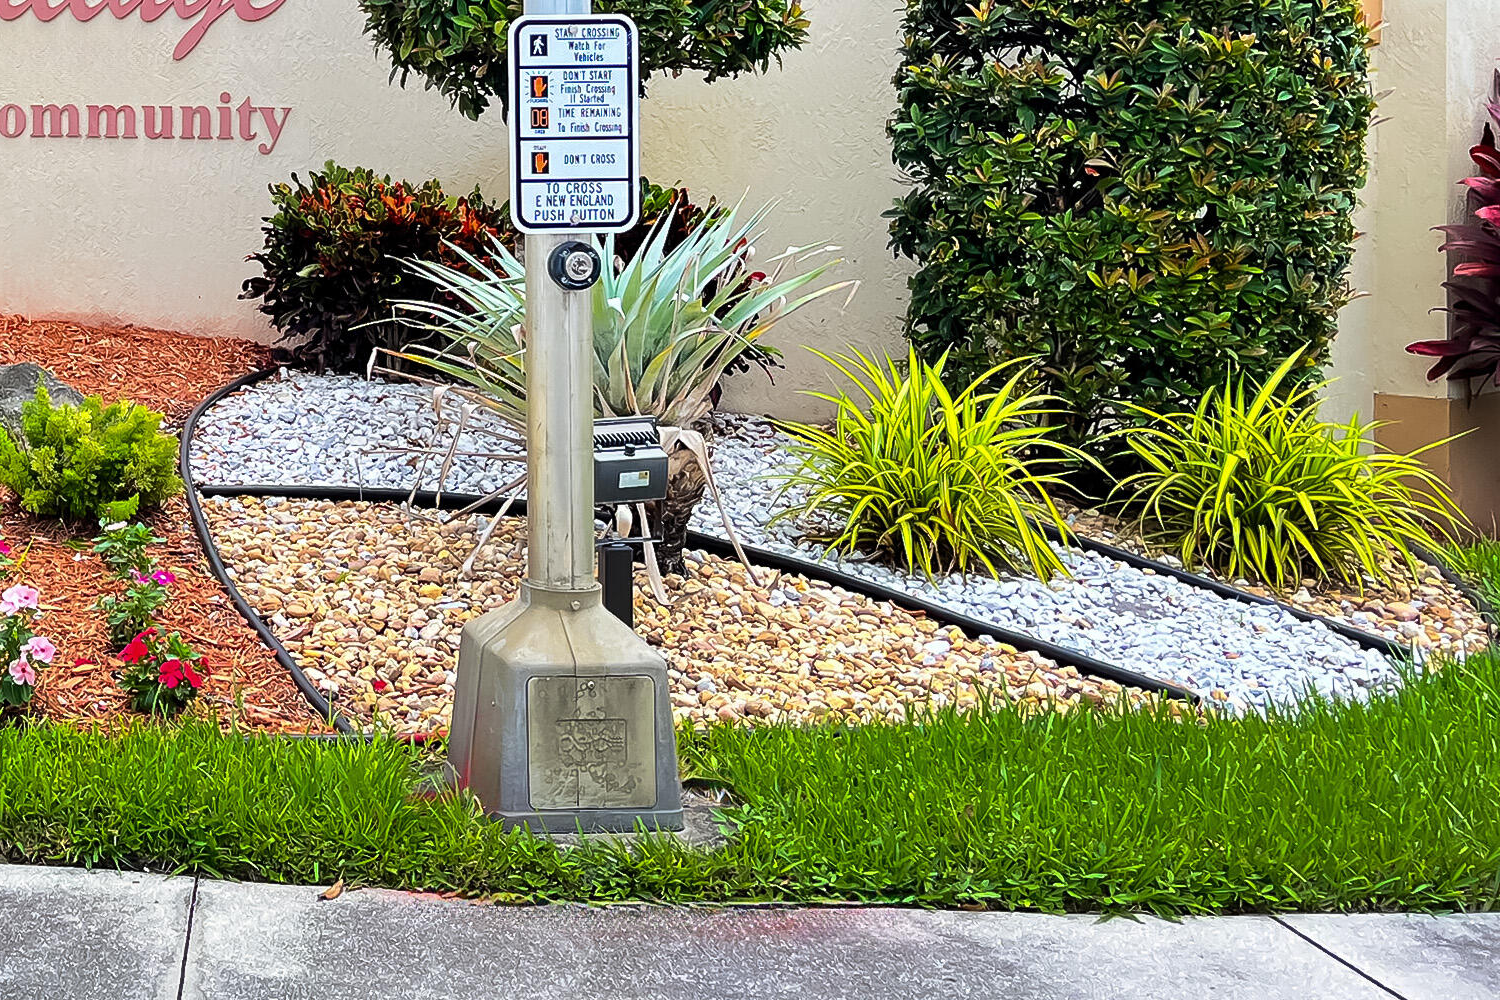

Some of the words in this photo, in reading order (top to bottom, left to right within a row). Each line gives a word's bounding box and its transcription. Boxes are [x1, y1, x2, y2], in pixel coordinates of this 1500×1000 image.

[582, 27, 620, 38] CROSSING
[568, 41, 590, 50] Watch
[594, 41, 606, 50] For
[574, 52, 604, 62] Vehicles
[563, 70, 586, 80] DON'T
[589, 70, 612, 80] START
[560, 84, 581, 94] Finish
[586, 84, 616, 95] Crossing
[580, 94, 604, 103] Started
[558, 107, 575, 118] TIME
[581, 107, 621, 118] REMAINING
[558, 122, 566, 132] To
[570, 122, 590, 132] Finish
[594, 122, 622, 134] Crossing
[564, 154, 586, 164] DON'T
[591, 154, 615, 164] CROSS
[546, 182, 560, 194] TO
[566, 182, 603, 194] CROSS
[536, 195, 542, 207] E
[546, 194, 566, 207] NEW
[570, 194, 614, 206] ENGLAND
[534, 209, 565, 221] PUSH
